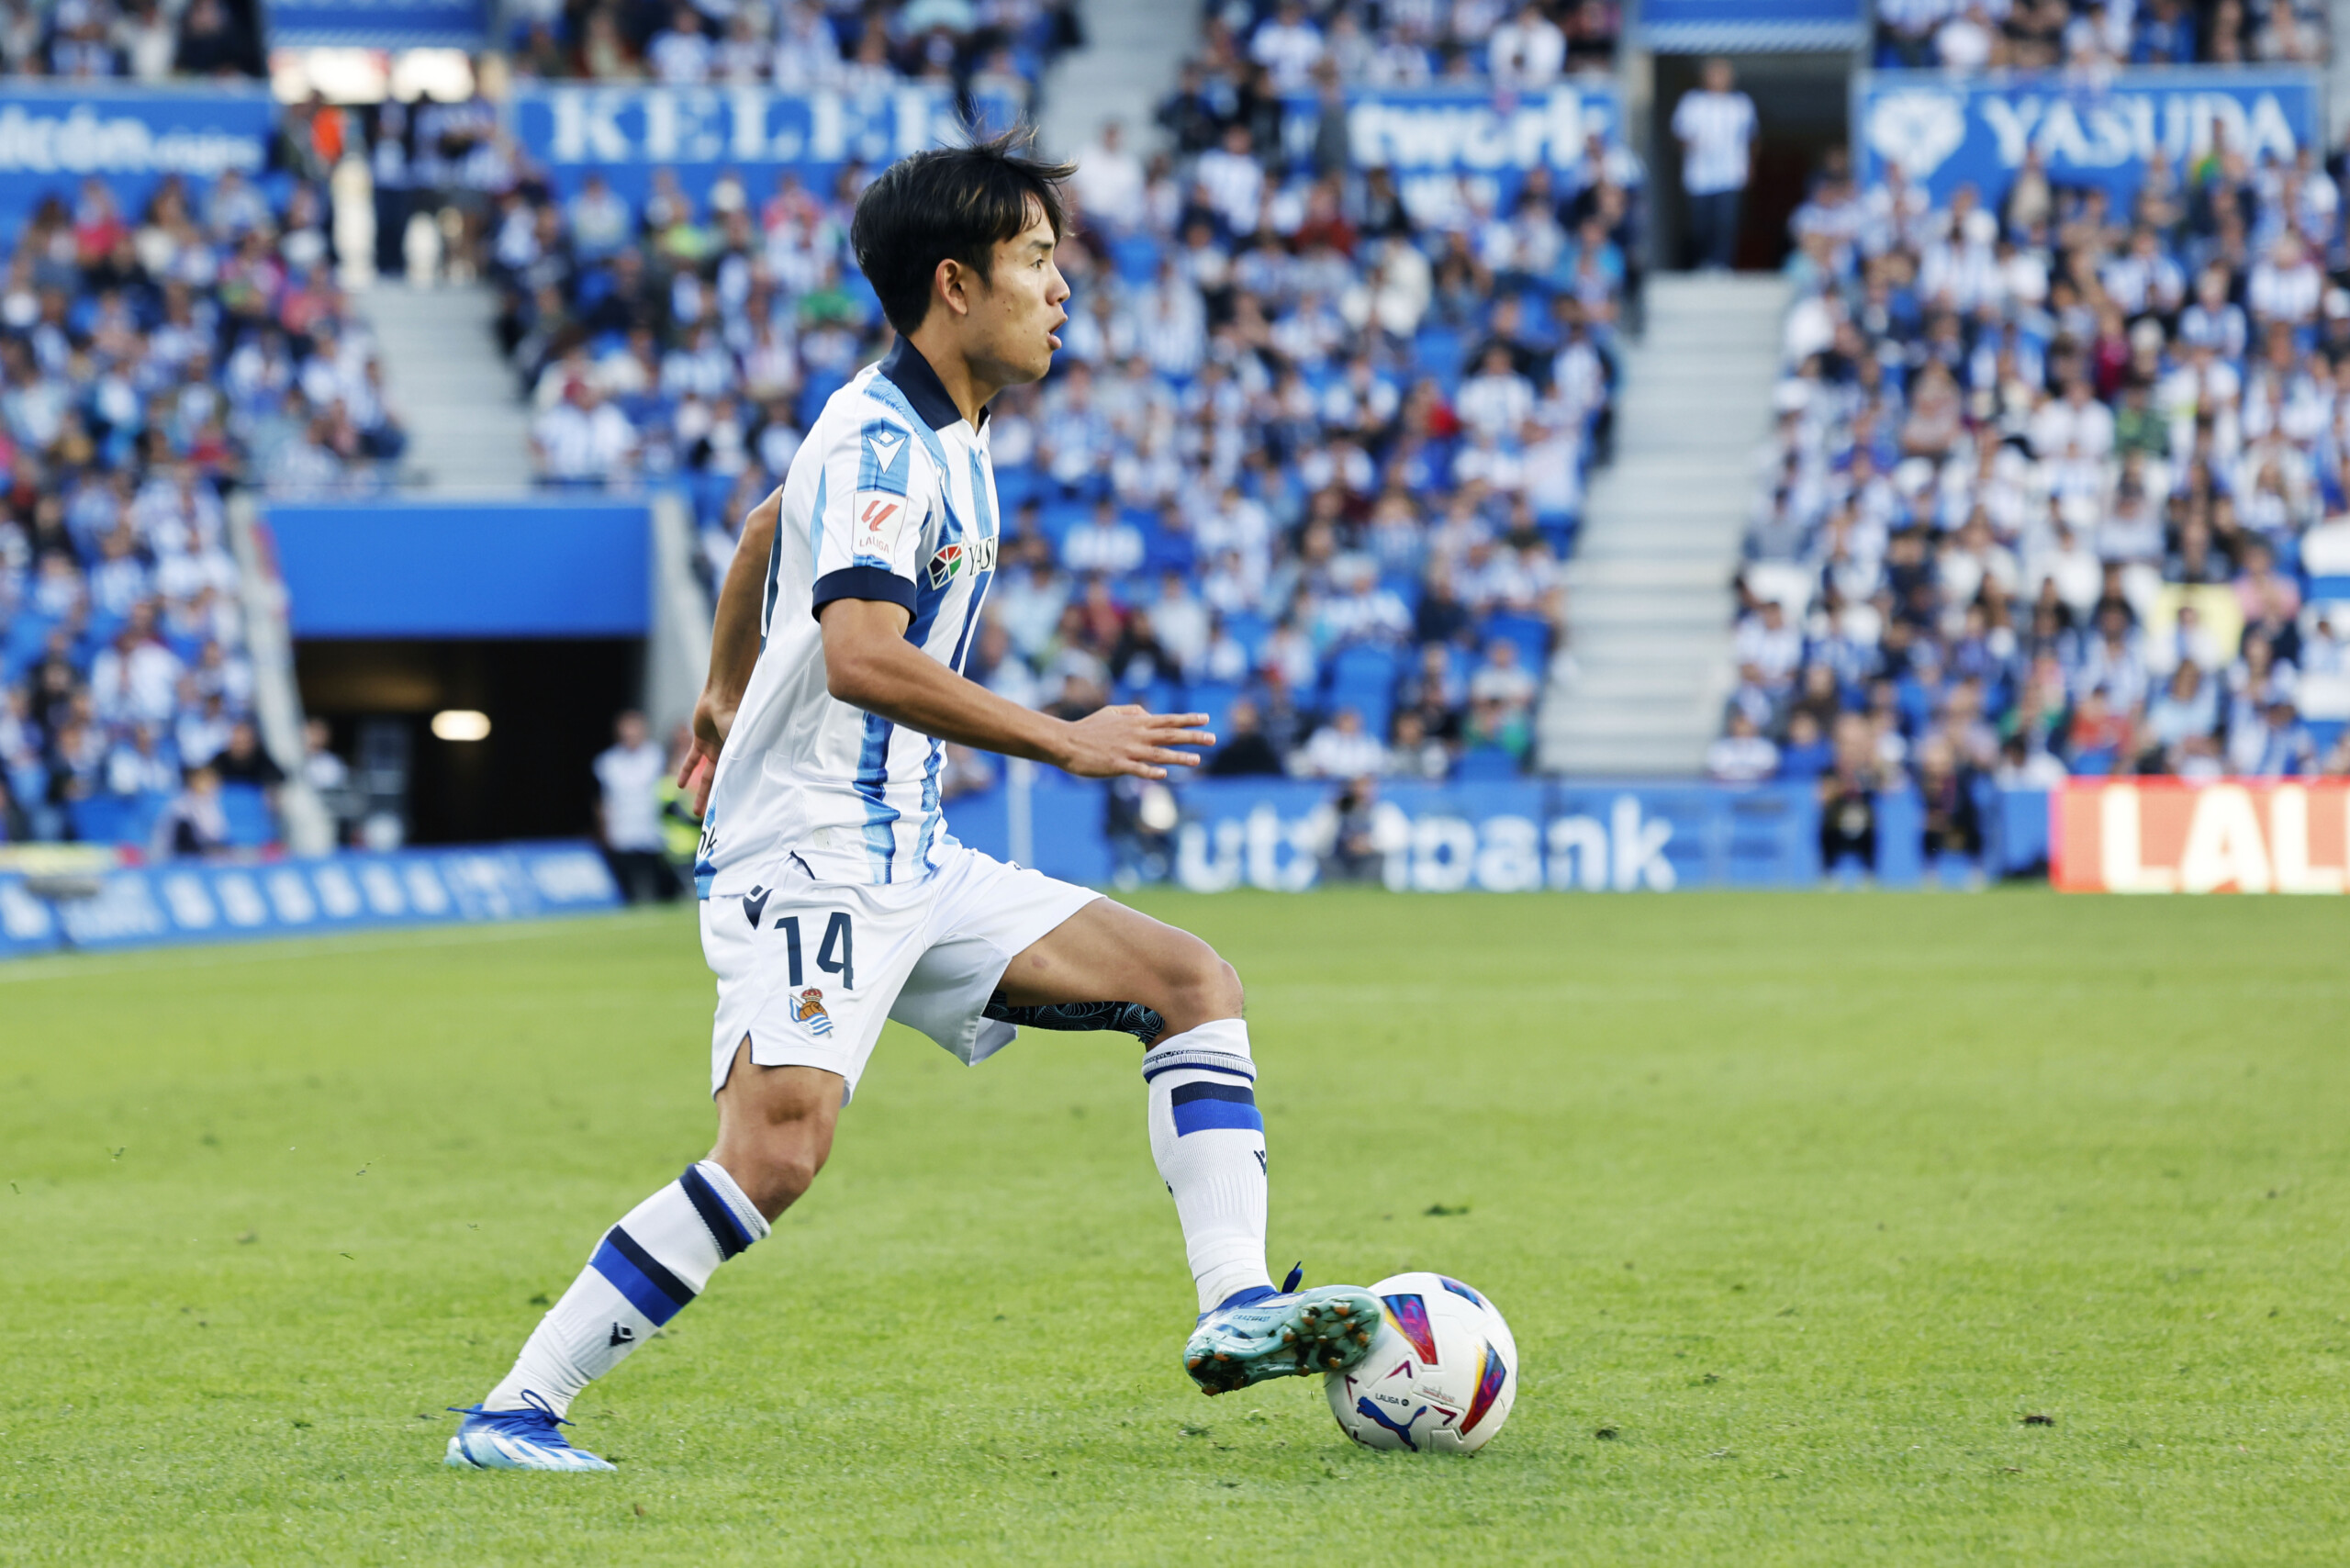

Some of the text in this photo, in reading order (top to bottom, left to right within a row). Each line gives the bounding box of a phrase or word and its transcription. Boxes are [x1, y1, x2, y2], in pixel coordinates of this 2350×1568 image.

[1982, 94, 2295, 169] YASUDA
[859, 535, 890, 554] LALIGA
[2099, 781, 2350, 893] LAL
[774, 912, 854, 991] 14
[1374, 1393, 1400, 1406] LALIGA
